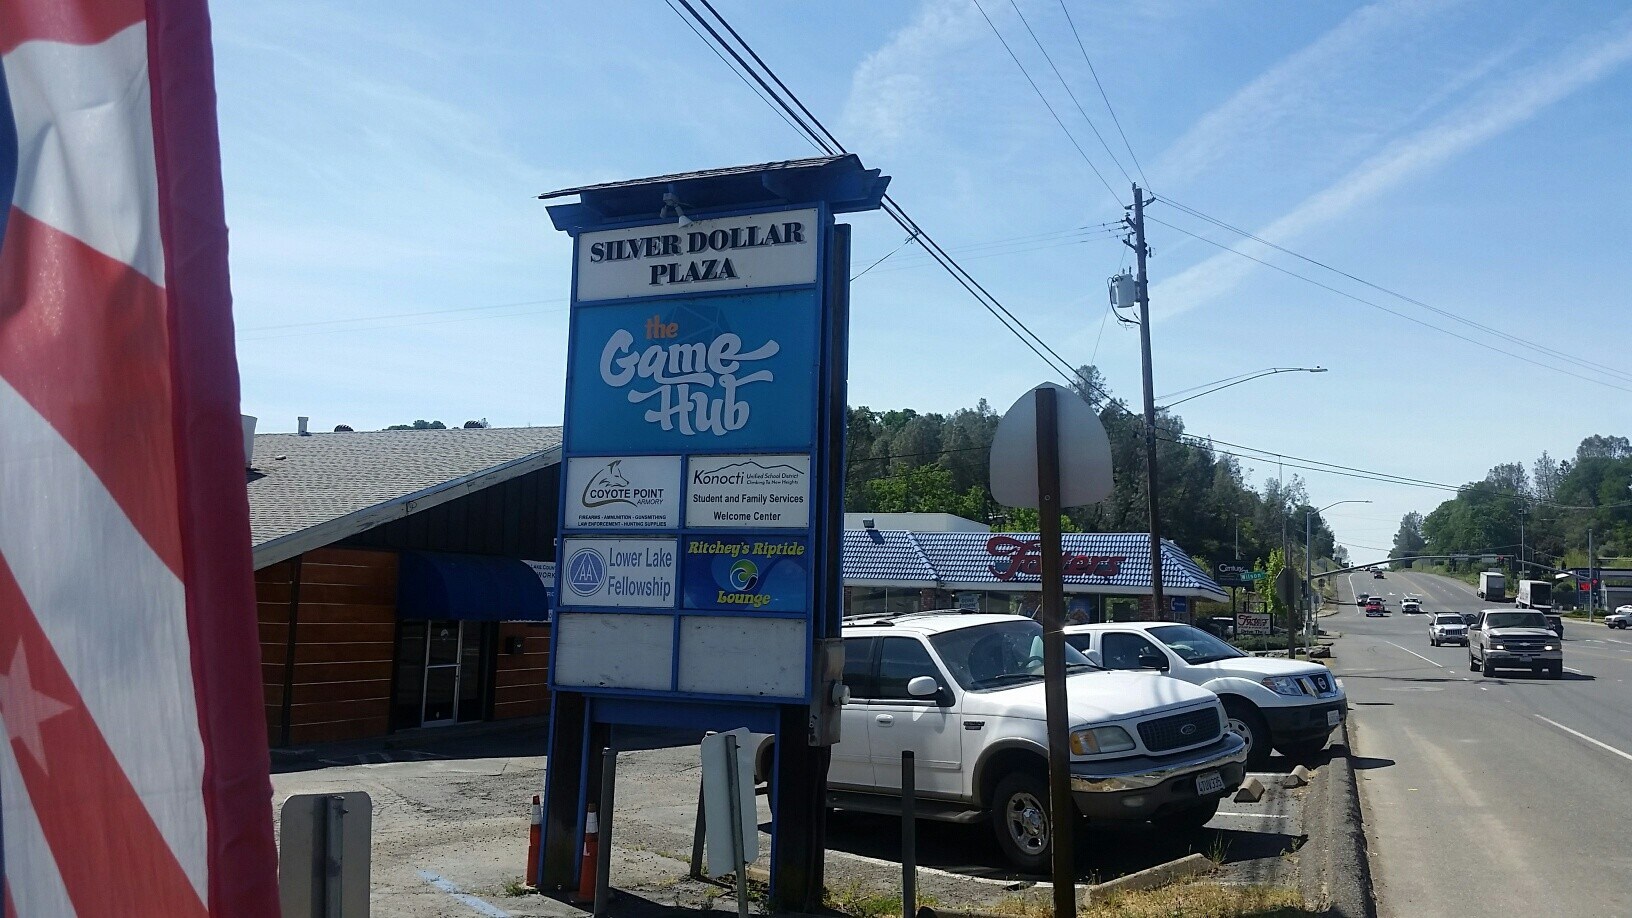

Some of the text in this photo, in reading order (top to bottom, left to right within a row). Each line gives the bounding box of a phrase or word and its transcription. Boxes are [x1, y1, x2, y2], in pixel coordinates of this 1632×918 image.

[590, 222, 806, 262] SILVER DOLLAR
[649, 257, 739, 285] PLAZA
[646, 314, 679, 339] the
[600, 329, 780, 388] Game
[627, 370, 774, 436] Hub
[693, 470, 745, 485] Konocti
[590, 488, 664, 499] COYOTE POINT
[693, 493, 804, 505] Student and Family Services
[713, 511, 781, 521] Welcome Center
[609, 547, 672, 567] Lower Lake
[688, 541, 805, 558] Ritchey's Riptide
[986, 536, 1127, 580] Foters
[580, 563, 593, 581] AA
[608, 576, 671, 601] Fellowship
[717, 591, 771, 608] Lounge
